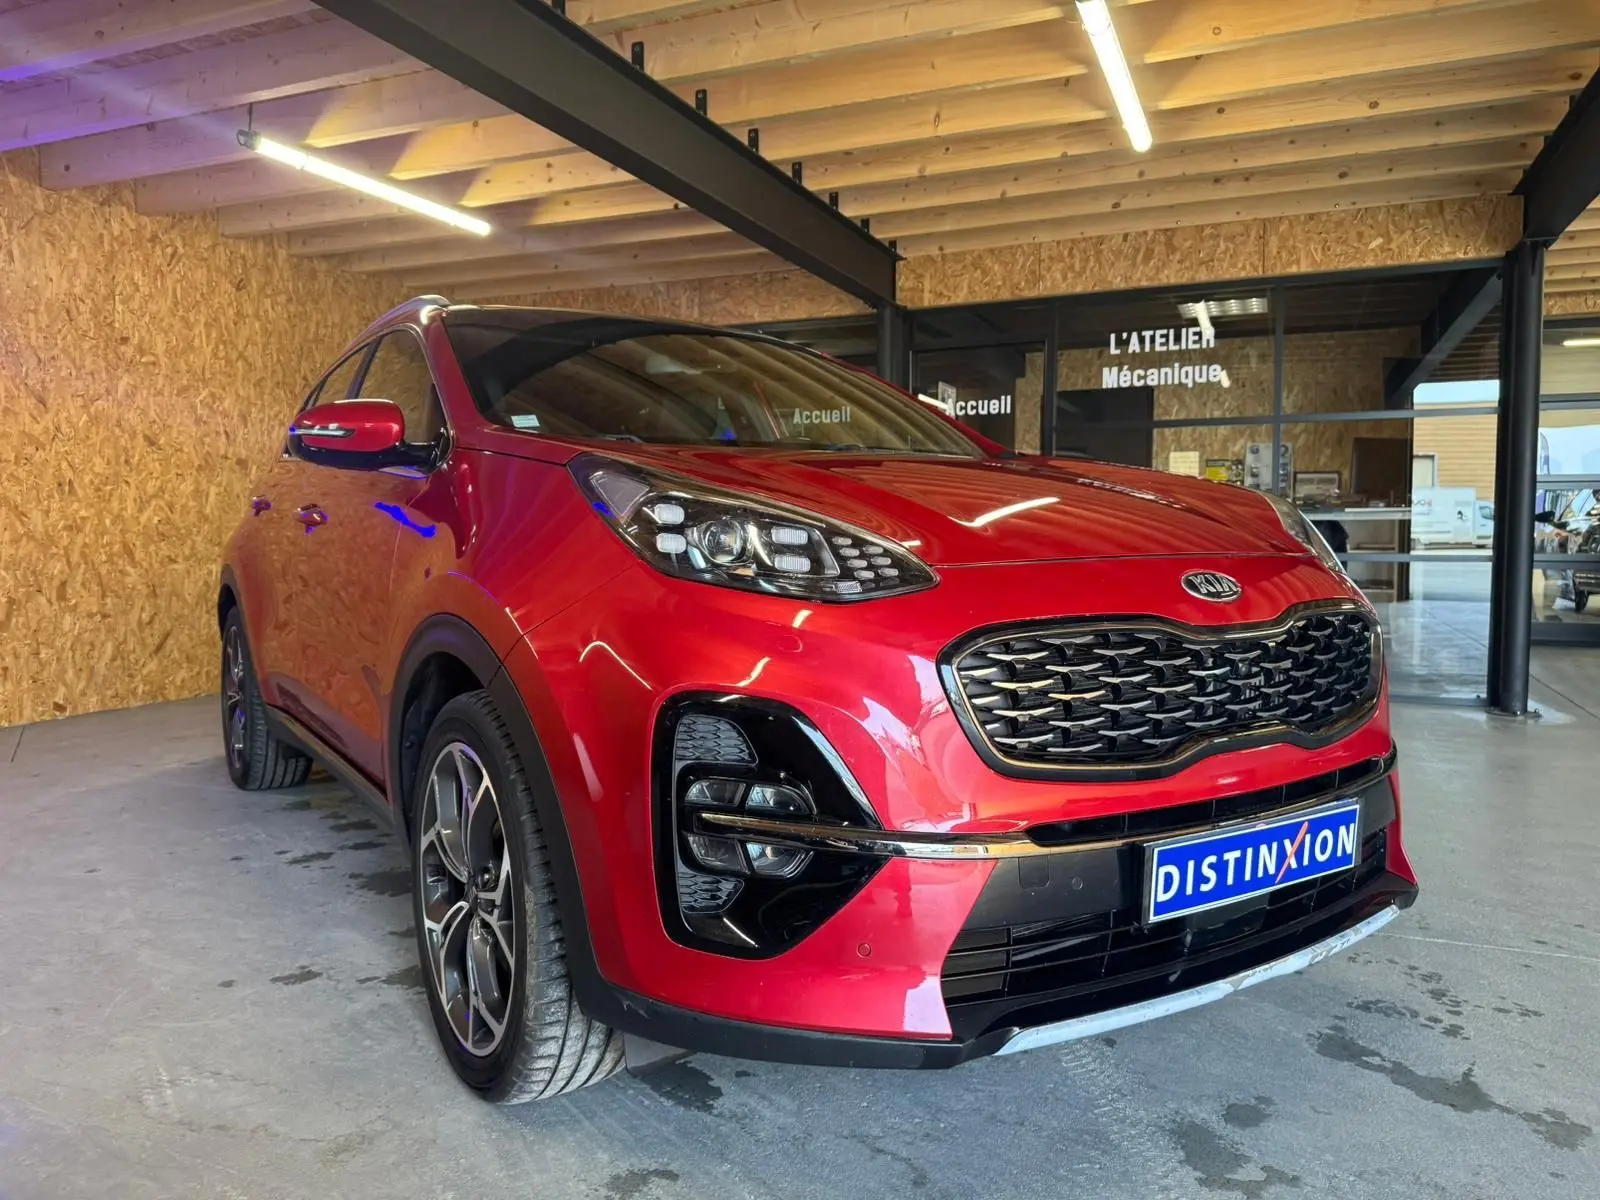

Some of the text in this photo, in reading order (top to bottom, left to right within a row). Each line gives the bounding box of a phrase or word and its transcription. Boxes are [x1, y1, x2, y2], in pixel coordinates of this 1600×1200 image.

[1110, 326, 1215, 355] L'ATELIER
[1102, 362, 1222, 389] Mécanique
[793, 405, 850, 424] Accueil
[946, 395, 1011, 419] Accueil
[1188, 574, 1238, 594] KIA
[1156, 821, 1355, 903] DISTINXION
